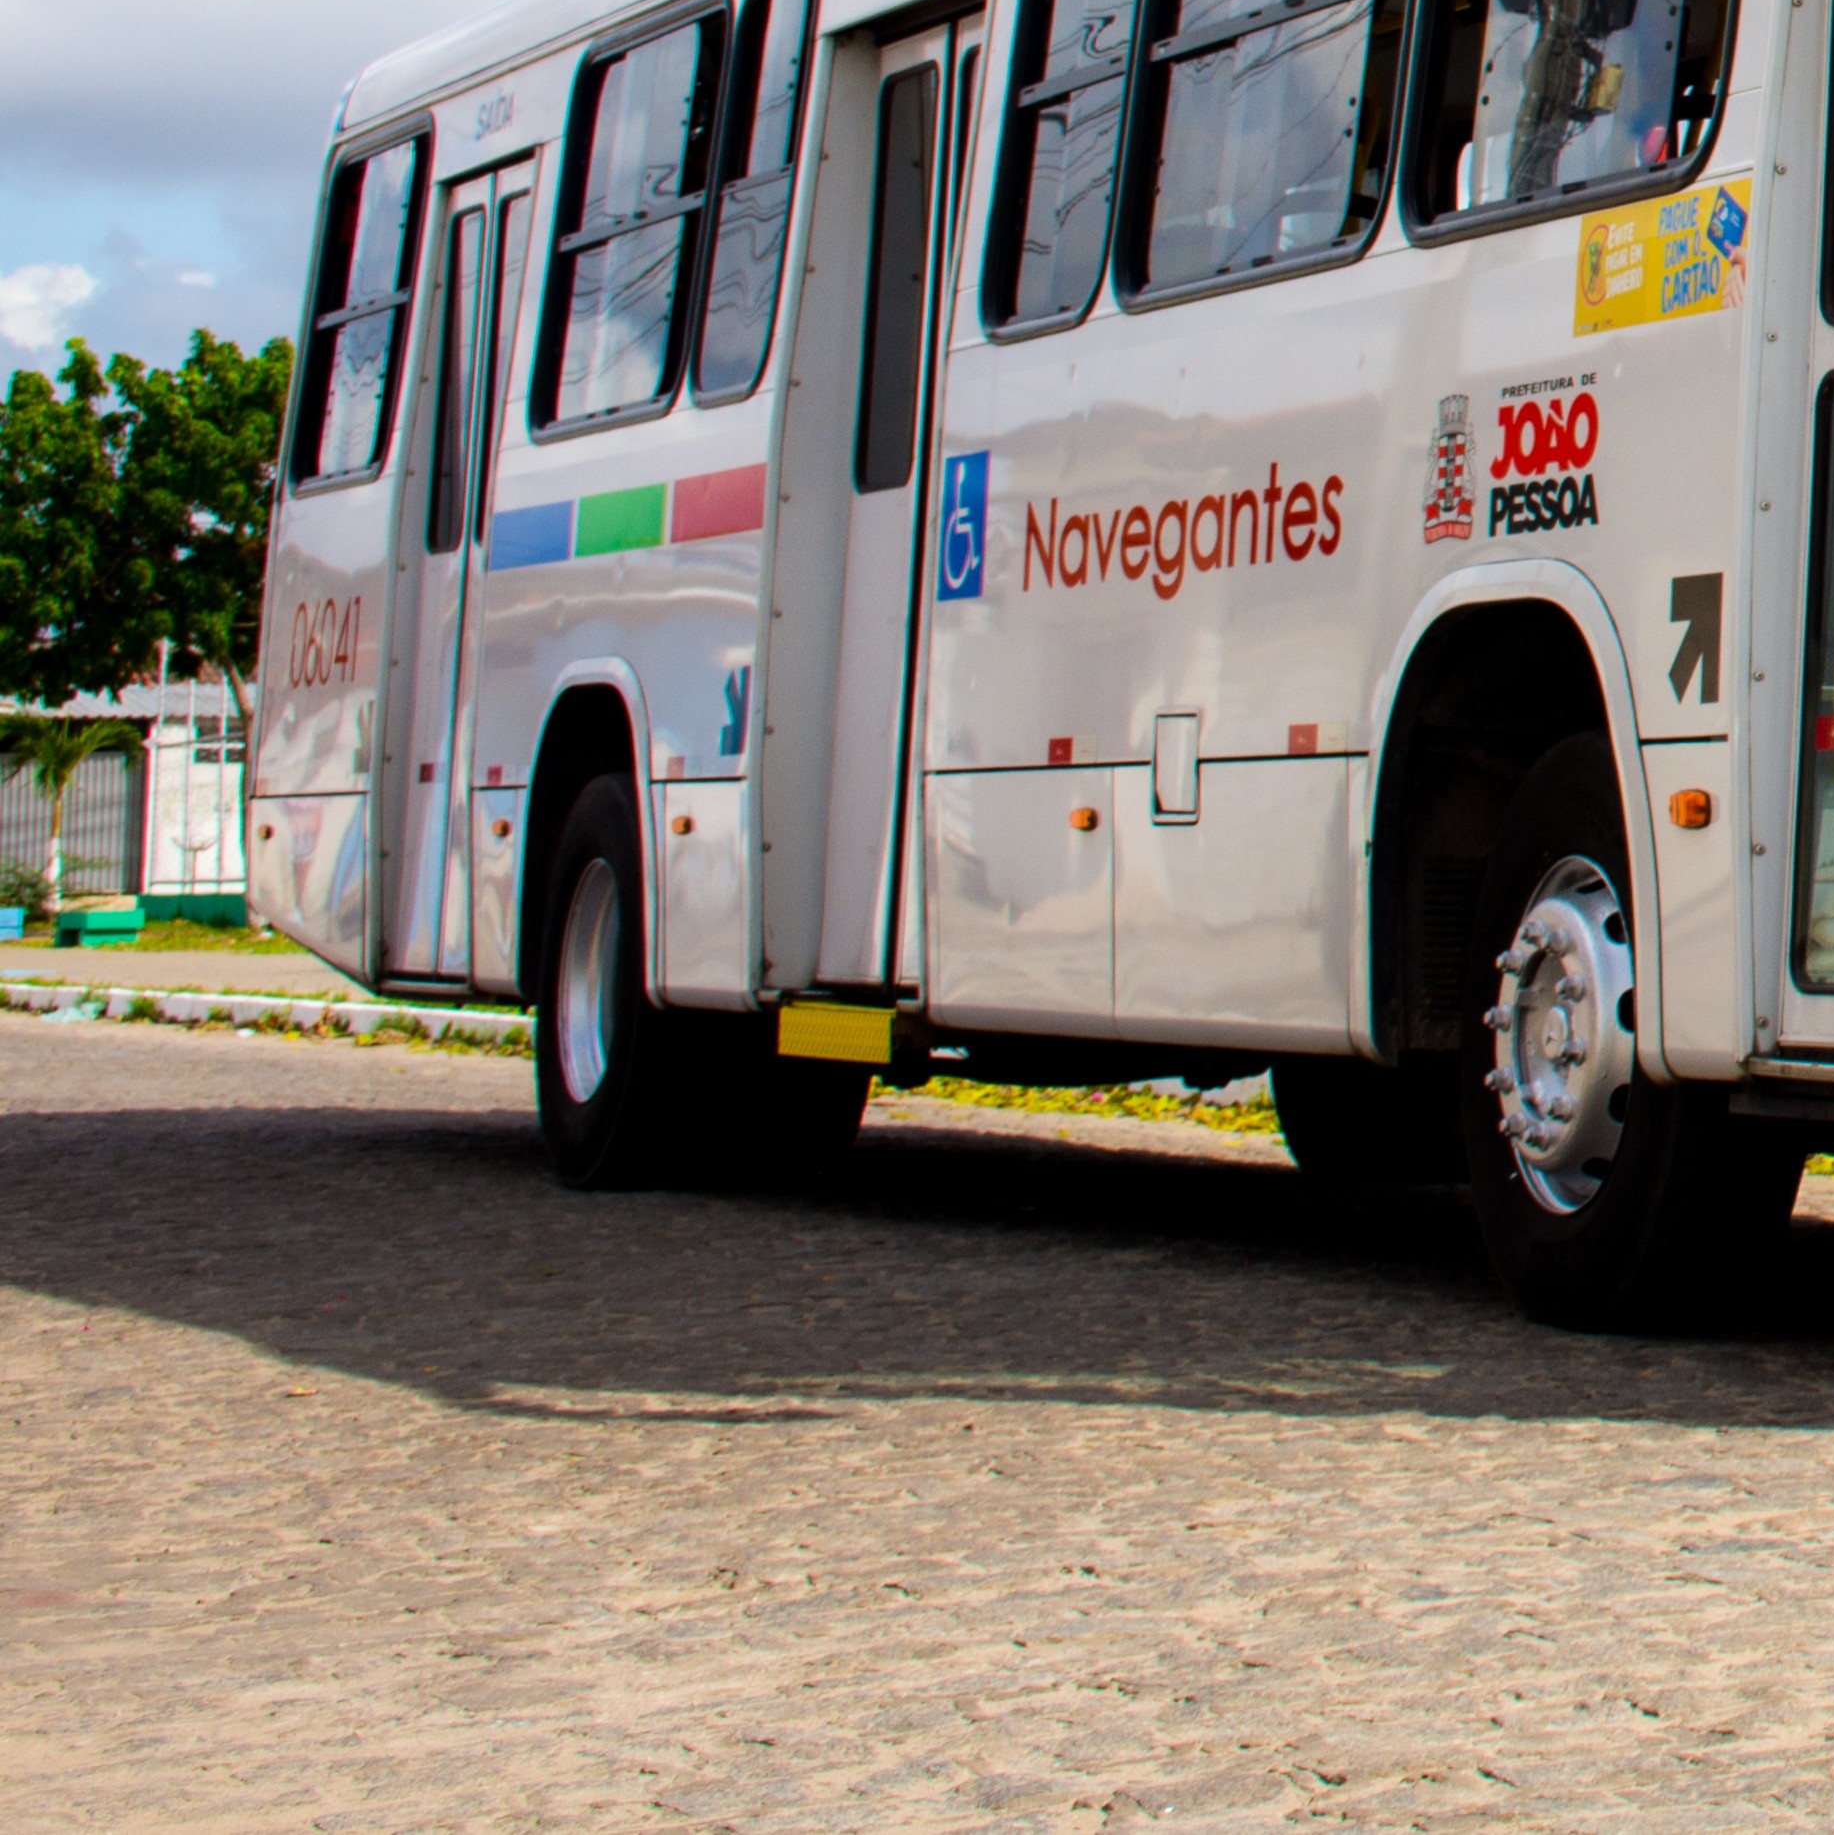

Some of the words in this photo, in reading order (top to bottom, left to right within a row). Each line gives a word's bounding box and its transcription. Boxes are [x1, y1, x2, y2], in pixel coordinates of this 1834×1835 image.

[473, 87, 516, 143] SAÍDA
[1657, 196, 1700, 238] PAGUE
[1664, 235, 1689, 269] COM
[1693, 229, 1701, 257] O
[1661, 250, 1721, 314] CARTÃO
[1501, 375, 1575, 399] PREFEITURA
[1580, 372, 1597, 386] DE
[1489, 391, 1600, 481] JOÃO
[1023, 461, 1345, 601] Navegantes
[1488, 473, 1599, 538] PESSOA
[289, 596, 362, 689] 06041
